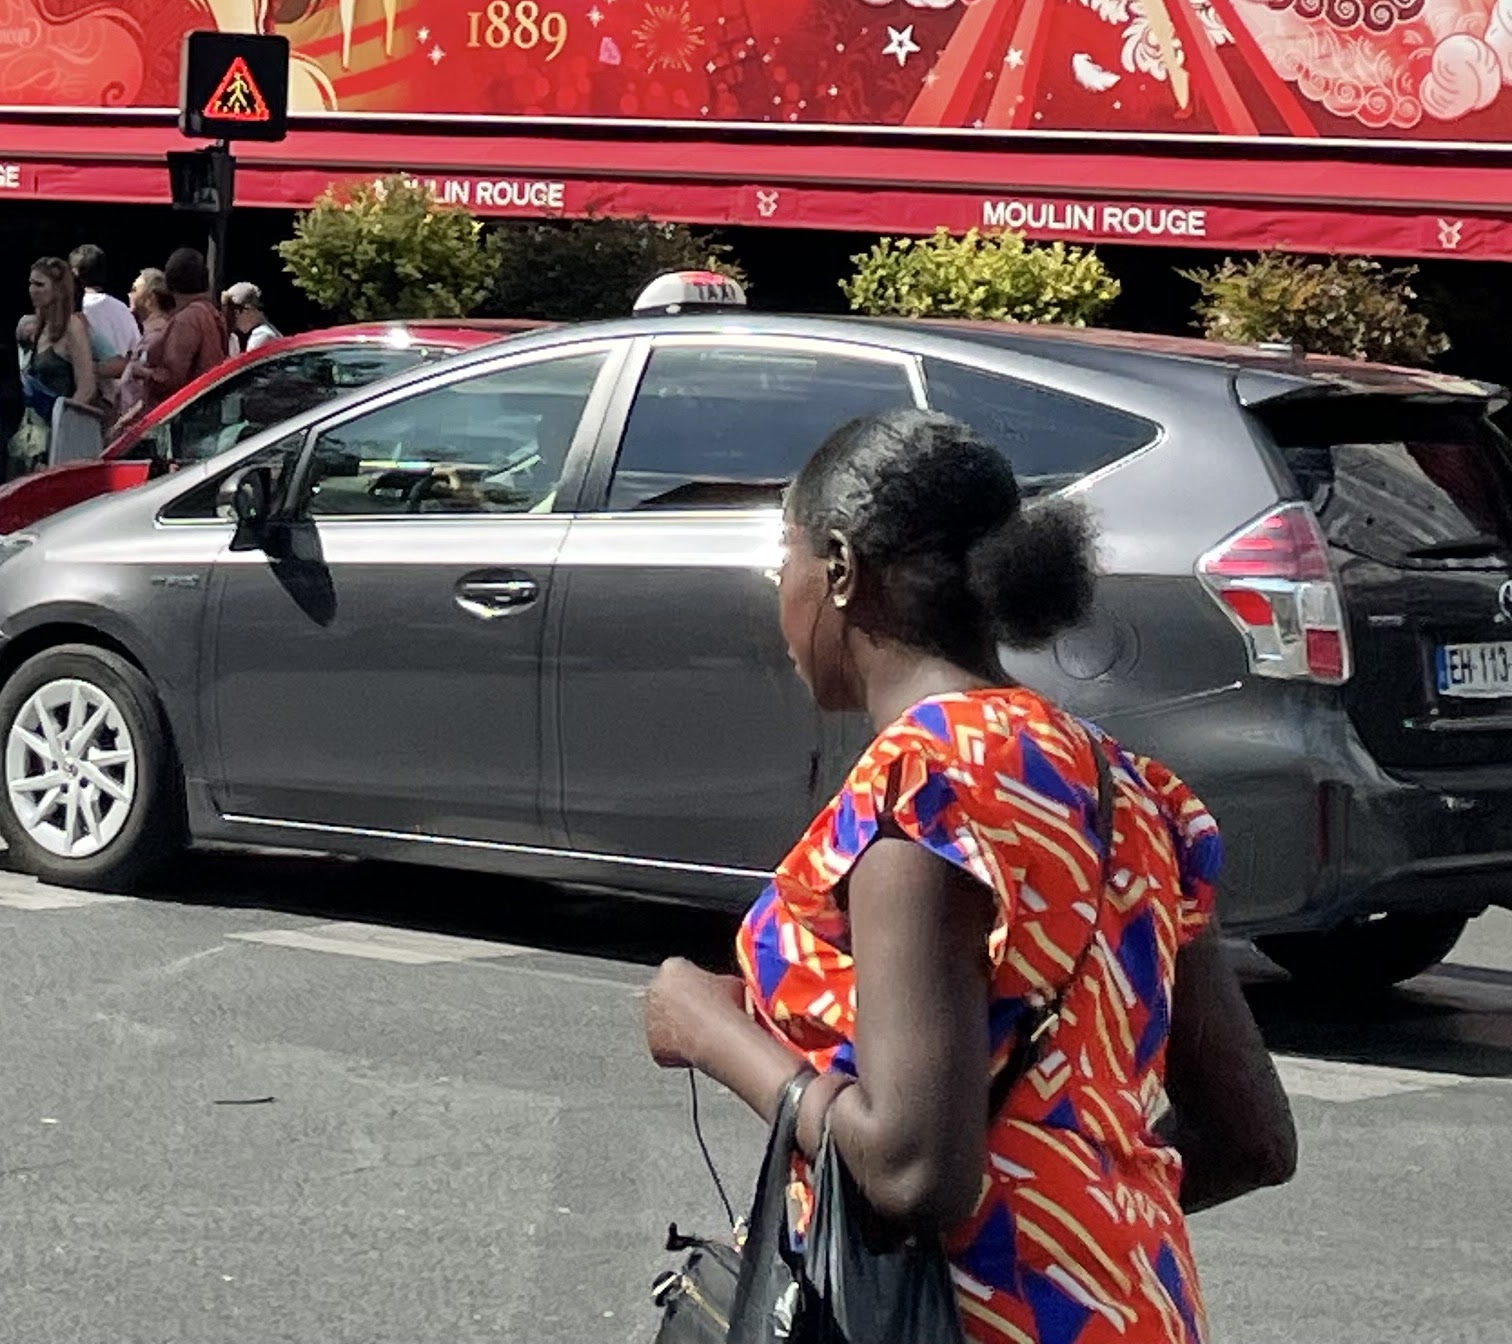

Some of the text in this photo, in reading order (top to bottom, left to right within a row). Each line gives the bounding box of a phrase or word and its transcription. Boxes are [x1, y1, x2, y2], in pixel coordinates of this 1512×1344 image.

[466, 0, 568, 62] 1889
[475, 181, 565, 208] ROUGE
[983, 200, 1207, 237] MOULIN ROUGE
[693, 283, 736, 301] TAXI
